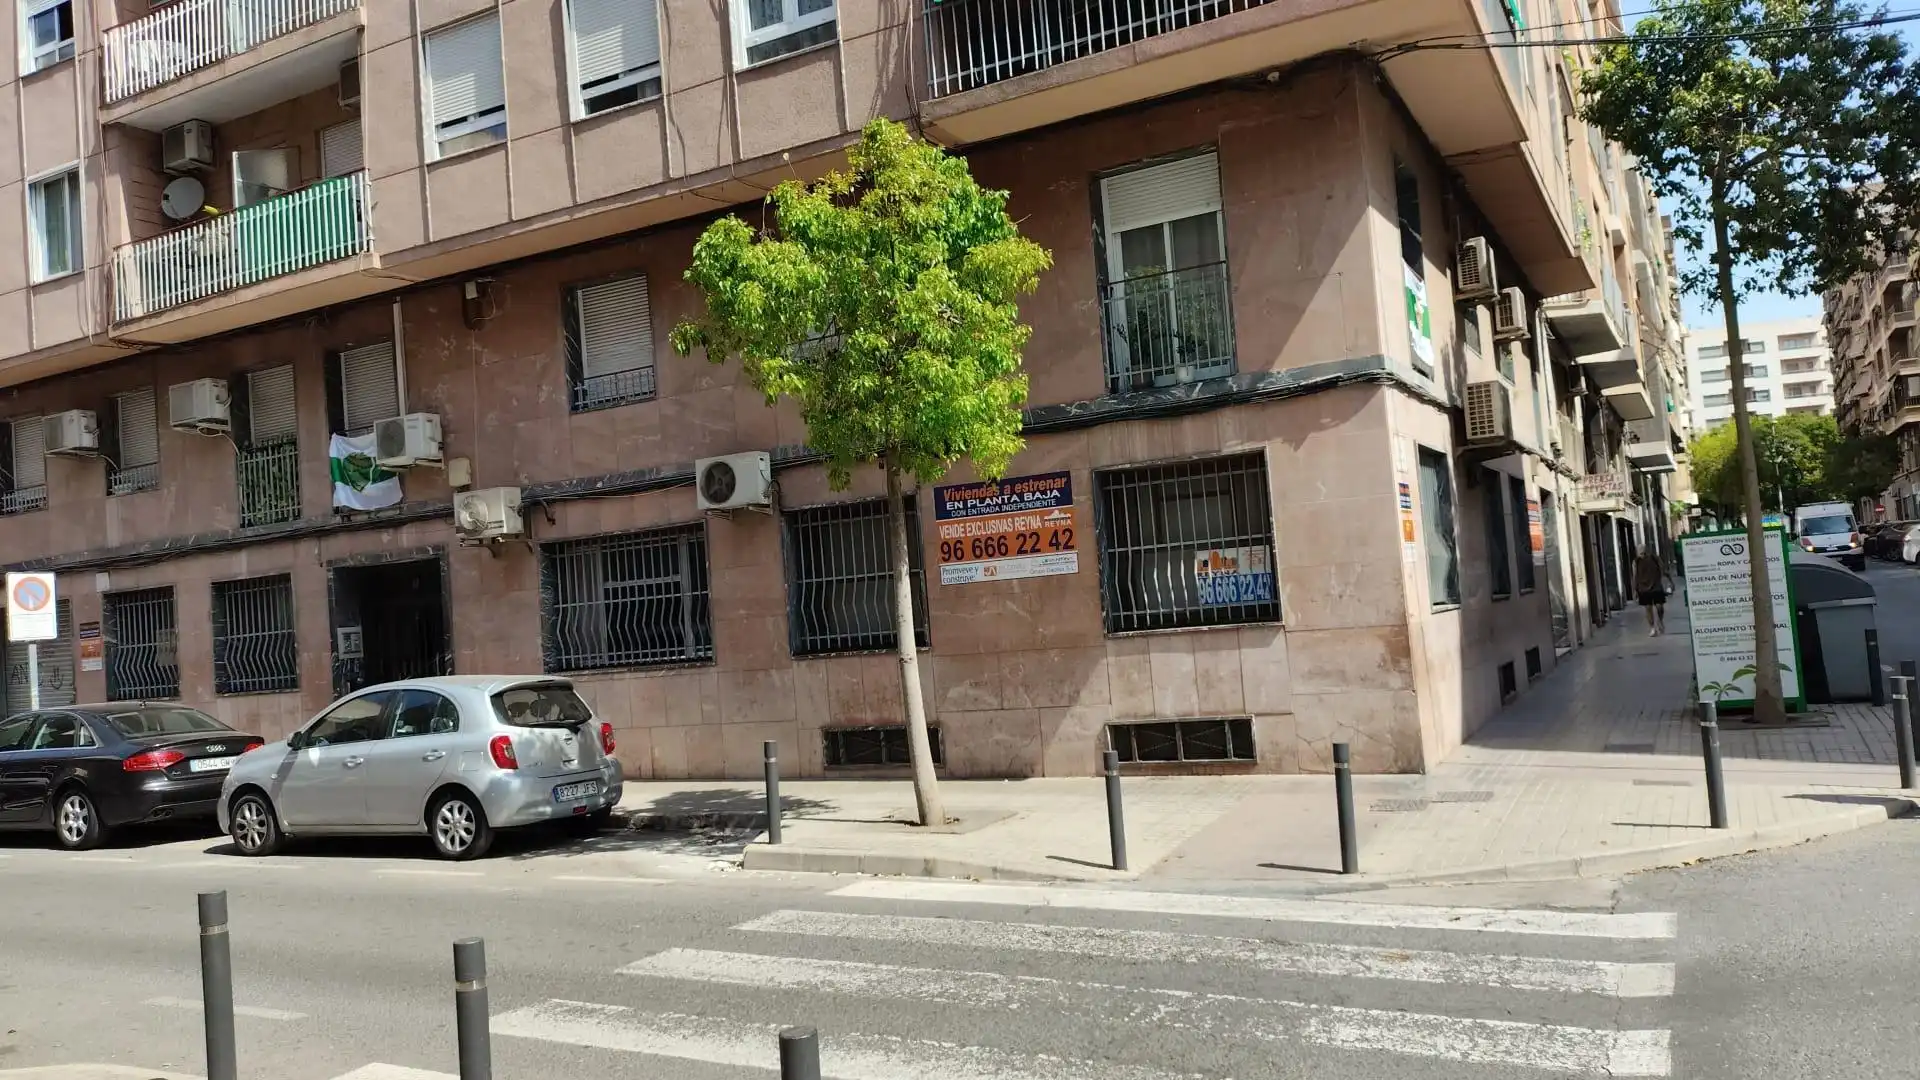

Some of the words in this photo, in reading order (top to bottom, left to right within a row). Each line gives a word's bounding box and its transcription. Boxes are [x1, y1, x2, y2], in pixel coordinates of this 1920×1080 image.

[943, 483, 1000, 501] Viviendas
[1004, 484, 1011, 495] a
[1015, 477, 1067, 494] estrenar
[946, 501, 963, 511] EN
[967, 494, 1022, 508] PLANTA
[1023, 489, 1060, 501] BAJA
[951, 510, 967, 518] CON
[967, 506, 1000, 516] ENTRADA
[1001, 499, 1057, 512] INDEPENDIENTE
[939, 523, 965, 539] VENDE
[966, 518, 1014, 537] EXCLUSIVAS
[1014, 514, 1043, 531] REYNA
[1043, 520, 1073, 528] REYNA
[940, 539, 965, 562] 96
[971, 534, 1009, 559] 666
[1015, 531, 1042, 555] 22
[1048, 528, 1075, 551] 42
[1199, 579, 1213, 604] 96
[1215, 576, 1237, 603] 666
[1239, 574, 1255, 601] 22
[1256, 573, 1271, 600] 42
[1689, 575, 1717, 583] SUENA
[1691, 598, 1725, 606] BANCOS
[1695, 625, 1747, 634] ALOJAMIENTO
[560, 785, 579, 798] 8227
[583, 782, 597, 794] JFS
